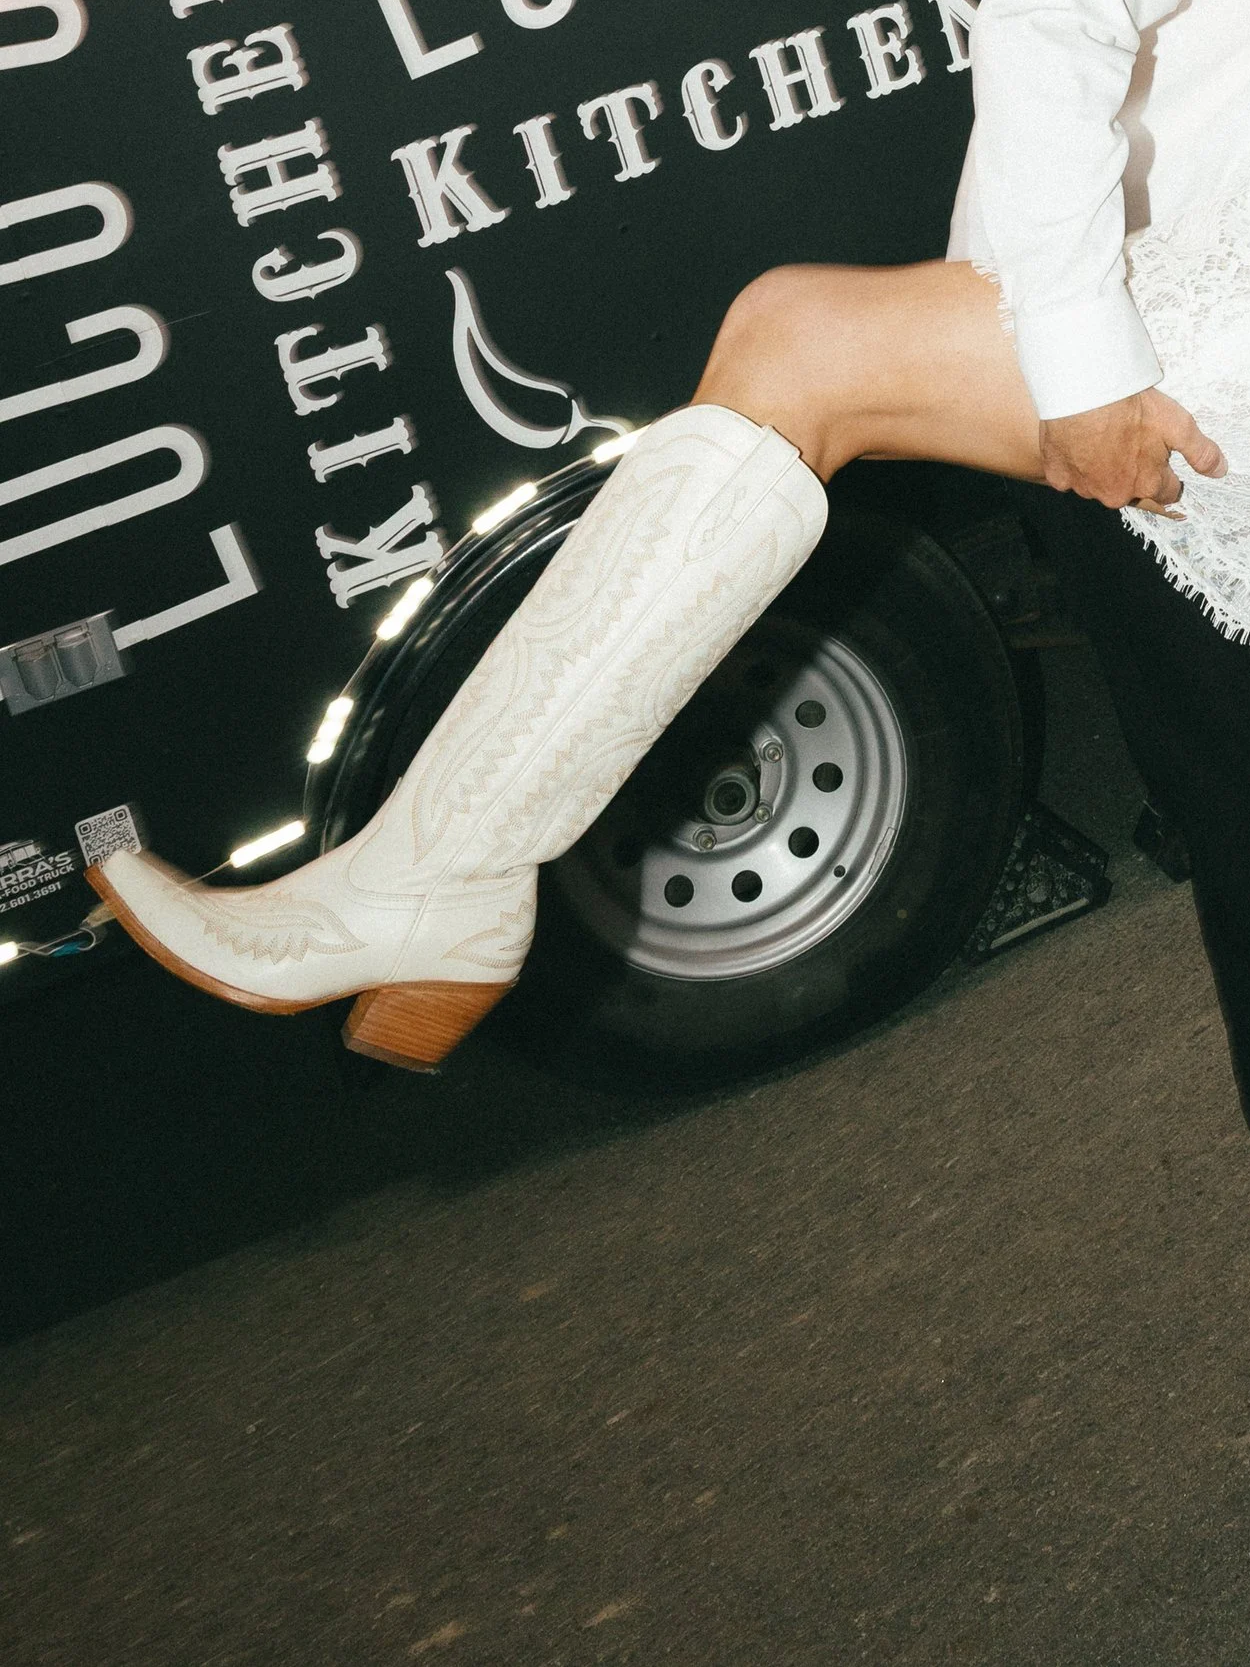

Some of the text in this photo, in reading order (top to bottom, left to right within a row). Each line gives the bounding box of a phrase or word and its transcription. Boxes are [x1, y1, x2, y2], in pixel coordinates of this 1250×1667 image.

[0, 851, 72, 891] RRA'S
[0, 863, 75, 899] -FOOD TRUCK
